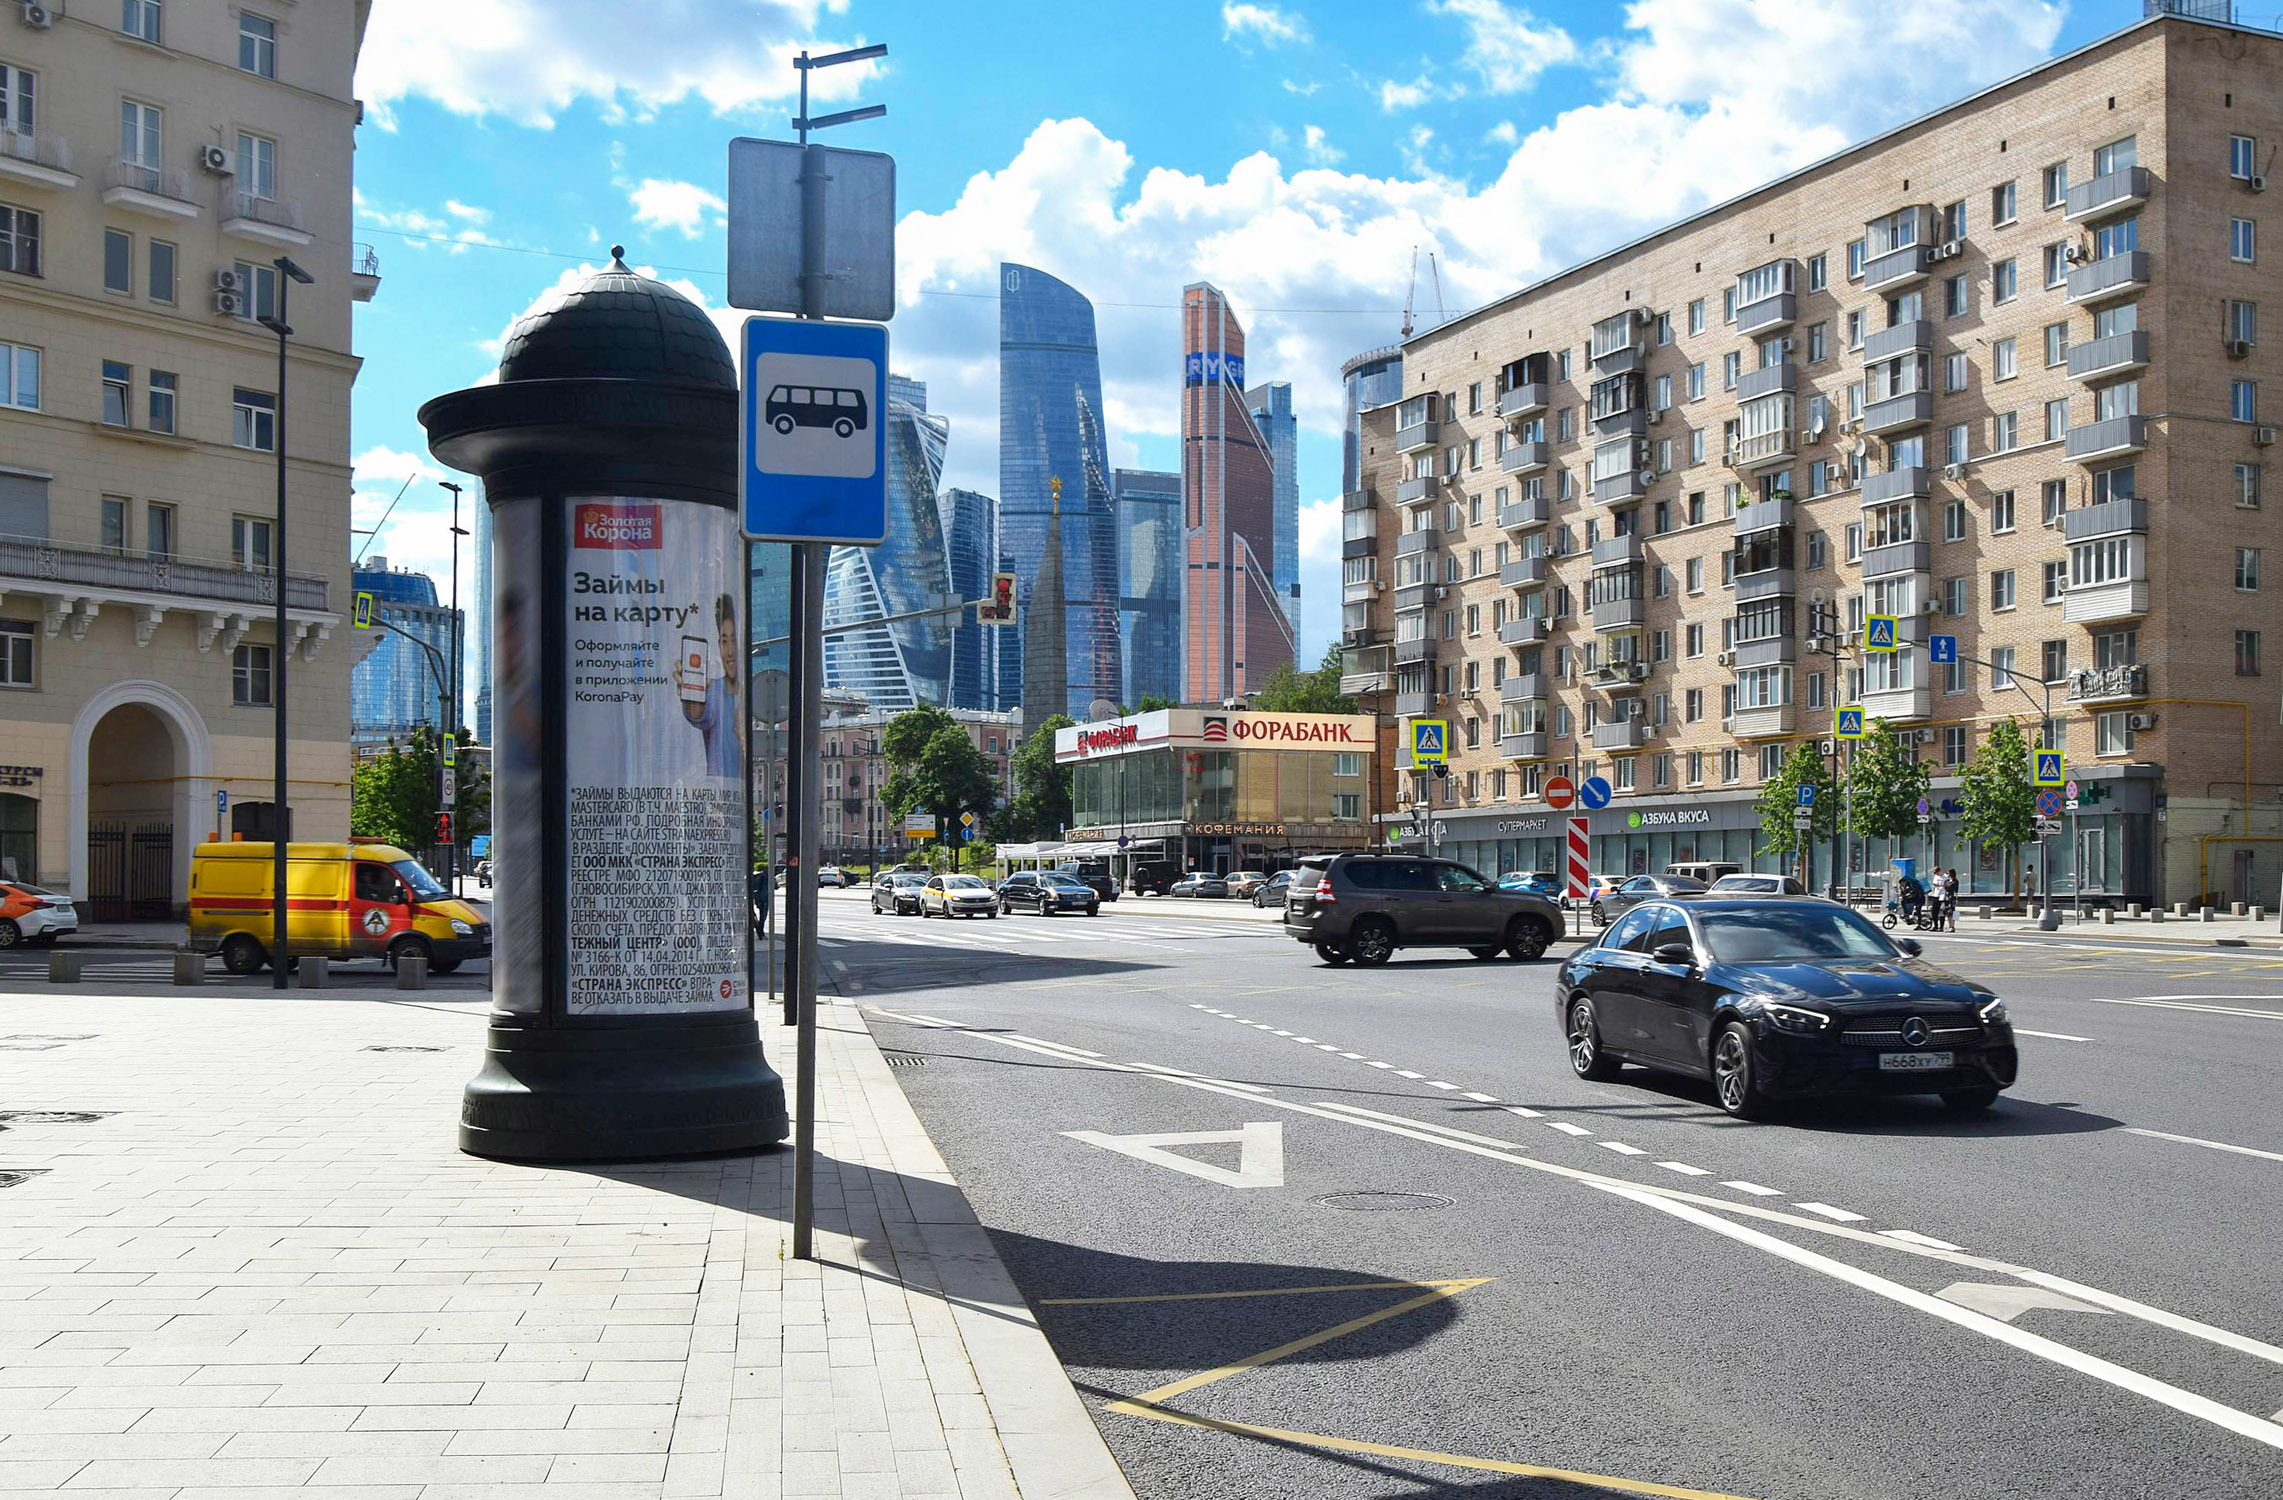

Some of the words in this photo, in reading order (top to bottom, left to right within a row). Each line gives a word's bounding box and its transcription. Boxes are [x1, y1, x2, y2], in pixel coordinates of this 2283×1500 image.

[600, 514, 652, 527] Золотая
[584, 523, 652, 543] Корона
[574, 572, 665, 594] Займы
[575, 606, 607, 621] на
[575, 639, 660, 652] Оформляйте
[575, 659, 583, 668] и
[587, 657, 654, 670] получайте
[586, 675, 668, 686] приложении
[575, 692, 644, 705] KoronaPay
[1233, 720, 1352, 742] ФОРАБАНК
[618, 788, 671, 801] ВЫДАЮТСЯ
[677, 788, 688, 800] НА
[692, 789, 716, 800] КАРТЫ
[1802, 787, 1812, 802] P
[572, 802, 633, 813] MASTERCARD
[572, 815, 622, 827] БАНКАМИ
[626, 815, 642, 827] РФ.
[647, 815, 703, 828] ПОДРОБНАЯ
[1642, 812, 1676, 825] АЗБУКА
[1678, 810, 1709, 823] ВКУСА
[1195, 824, 1285, 835] КОФЕМАНИЯ
[1498, 819, 1547, 833] СУПЕРМАРКЕТ
[571, 828, 604, 840] УСЛУГЕ
[616, 828, 629, 840] НА
[631, 827, 660, 840] САЙТЕ
[662, 828, 731, 841] STRANAEXPRESS.RU
[573, 842, 579, 854] В
[581, 842, 623, 856] РАЗДЕЛЕ
[625, 842, 698, 855] «ДОКУМЕНТЫ».
[699, 843, 718, 854] ЗАЕМ
[572, 857, 581, 868] ЕТ
[584, 856, 606, 868] ООО
[608, 856, 632, 868] МКК
[635, 856, 680, 868] «СТРАНА
[682, 856, 725, 868] ЭКСПРЕСС»
[572, 870, 611, 881] РЕЕСТРЕ
[616, 870, 641, 881] МФО
[572, 897, 596, 908] ОГРН
[605, 897, 682, 909] 1121902000879).
[572, 910, 628, 922] ДЕНЕЖНЫХ
[633, 910, 675, 922] СРЕДСТВ
[572, 924, 601, 935] СКОГО
[605, 924, 634, 935] СЧЕТА
[572, 935, 620, 949] ТЕЖНЫЙ
[627, 938, 668, 952] ЦЕНТР»
[586, 951, 621, 963] 3166-К
[624, 951, 638, 962] ОТ
[642, 951, 693, 963] 14.04.2014
[572, 964, 585, 976] УЛ.
[589, 964, 631, 977] КИРОВА,
[633, 964, 648, 977] 86,
[572, 978, 622, 990] «СТРАНА
[626, 978, 687, 990] ЭКСПРЕСС»
[691, 978, 716, 990] ВПРА-
[572, 992, 583, 1004] ВЕ
[585, 992, 633, 1004] ОТКАЗАТЬ
[636, 992, 642, 1003] В
[644, 992, 683, 1005] ВЫДАЧЕ
[685, 990, 715, 1003] ЗАЙМА.
